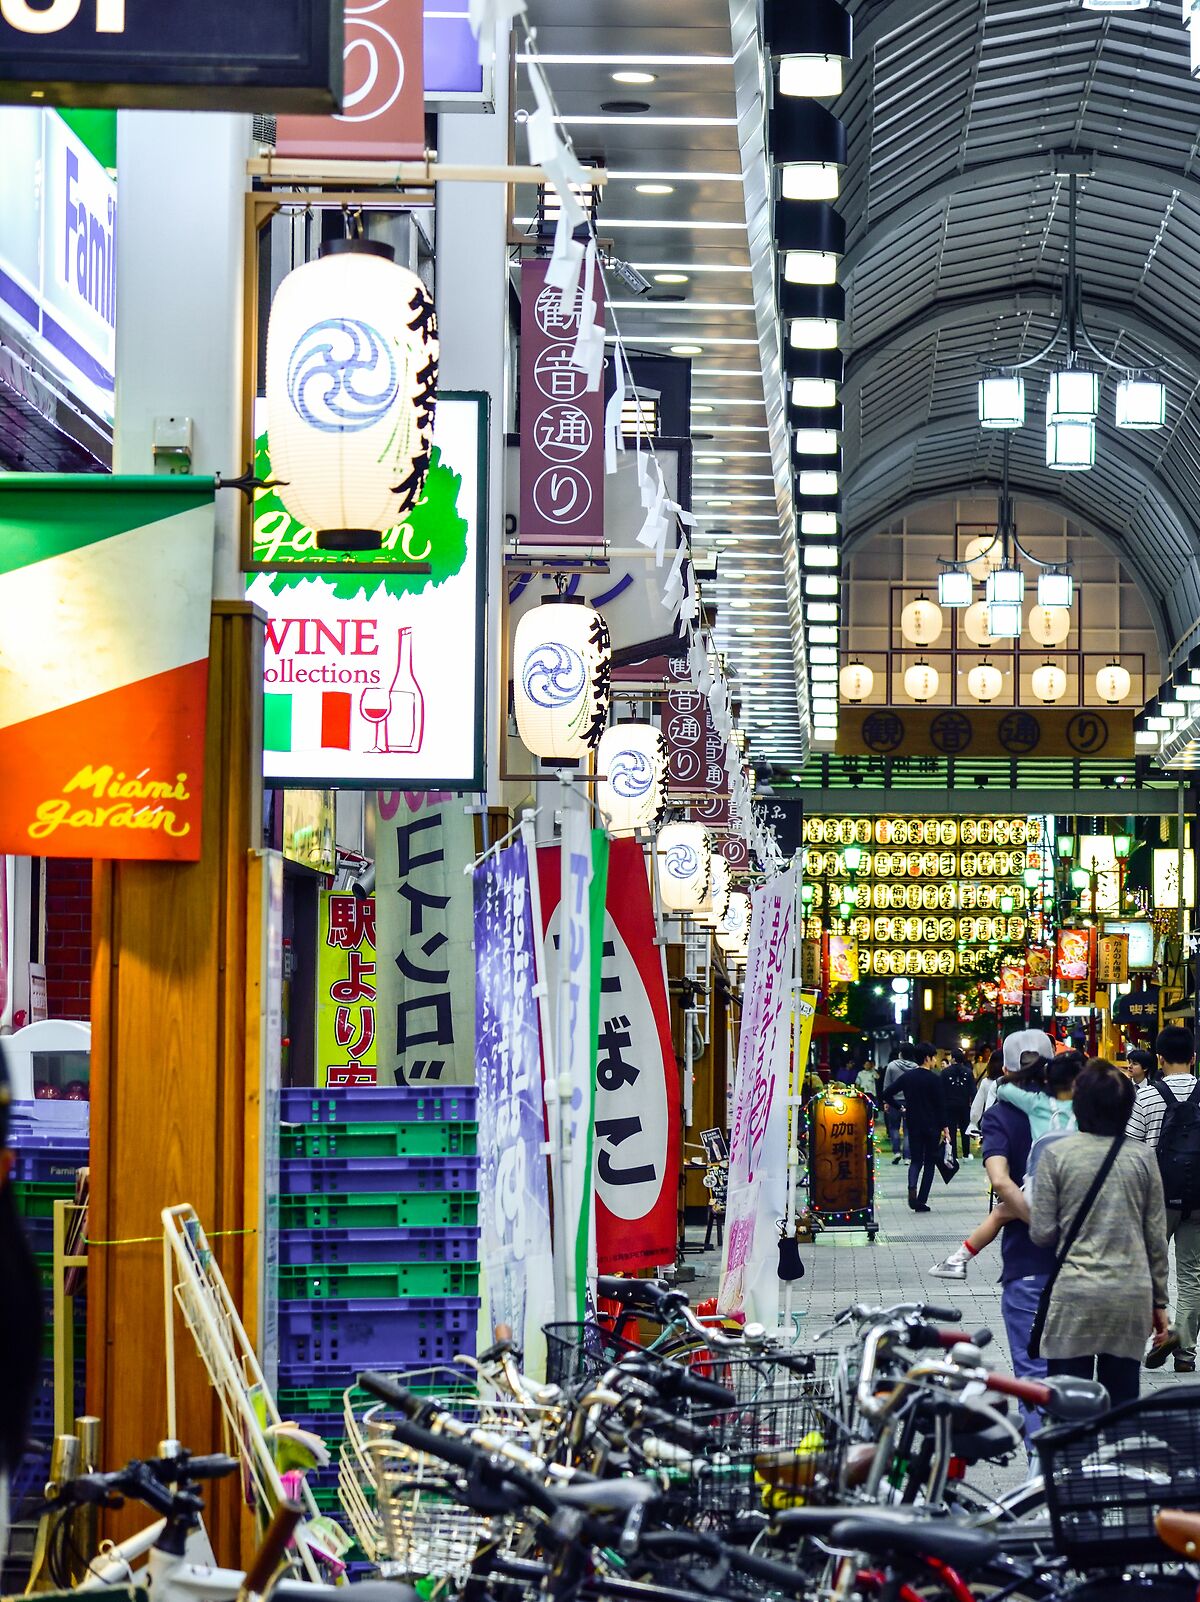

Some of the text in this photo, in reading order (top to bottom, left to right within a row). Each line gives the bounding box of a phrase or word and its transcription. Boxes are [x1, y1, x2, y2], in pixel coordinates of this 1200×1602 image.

[264, 619, 380, 656] WINE
[264, 660, 381, 684] ollections
[862, 711, 1108, 754] 観音通り
